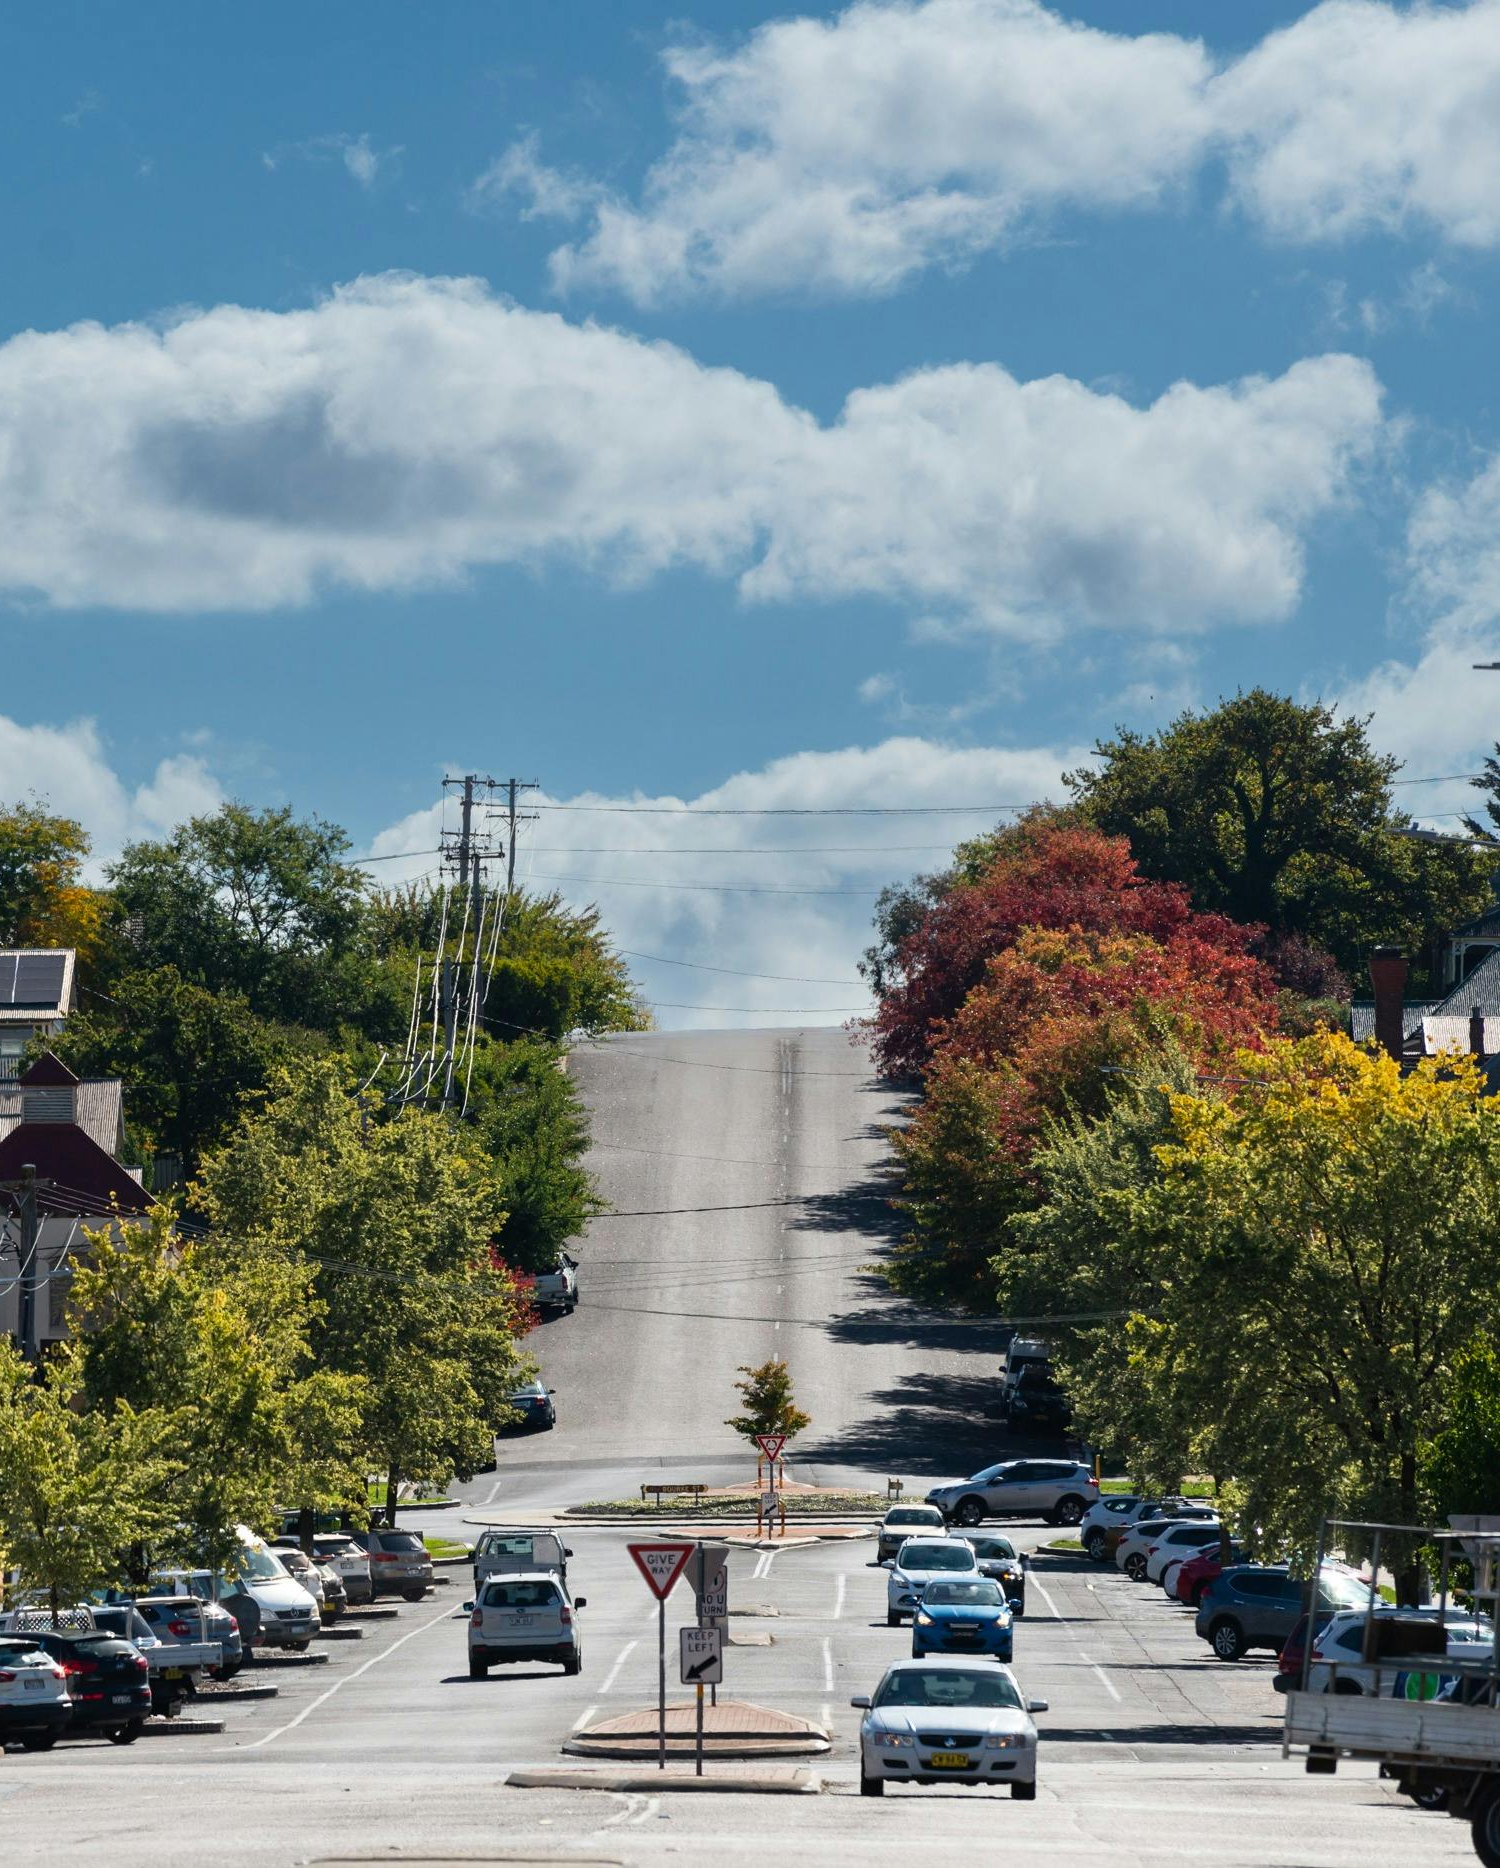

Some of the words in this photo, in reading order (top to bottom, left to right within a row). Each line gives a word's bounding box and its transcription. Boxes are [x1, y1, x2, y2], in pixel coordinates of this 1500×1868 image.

[647, 1554, 676, 1565] GIVE
[651, 1566, 672, 1574] WAY
[717, 1594, 724, 1605] U
[687, 1631, 714, 1641] KEEP
[688, 1643, 713, 1652] LEFT
